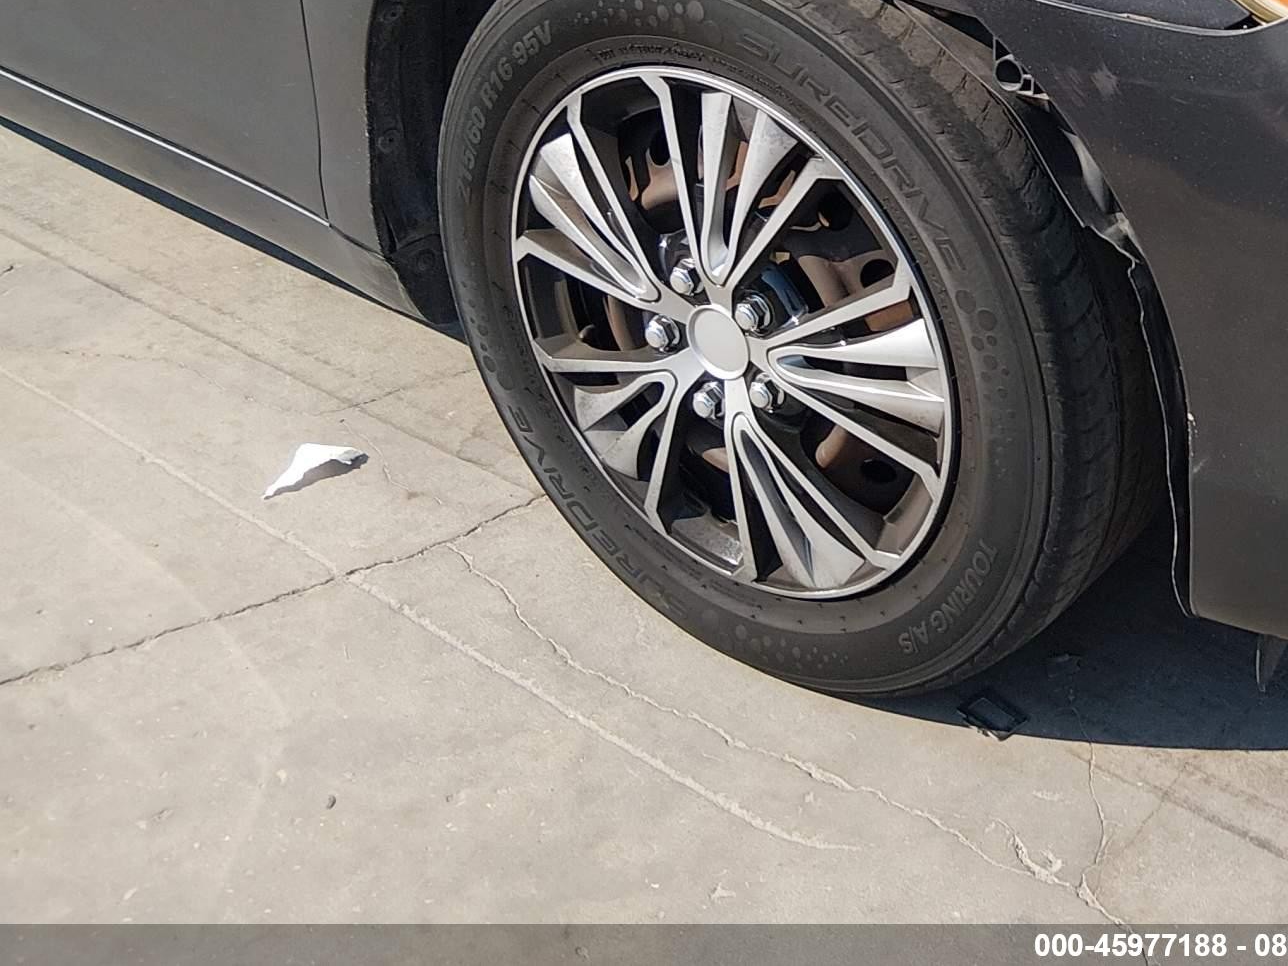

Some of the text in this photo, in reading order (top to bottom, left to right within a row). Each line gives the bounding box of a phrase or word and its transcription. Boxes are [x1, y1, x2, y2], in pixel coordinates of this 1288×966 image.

[479, 56, 514, 110] R16
[511, 18, 552, 66] 95V
[735, 32, 967, 272] SUREDRIVE
[898, 537, 999, 654] TOURING A/S
